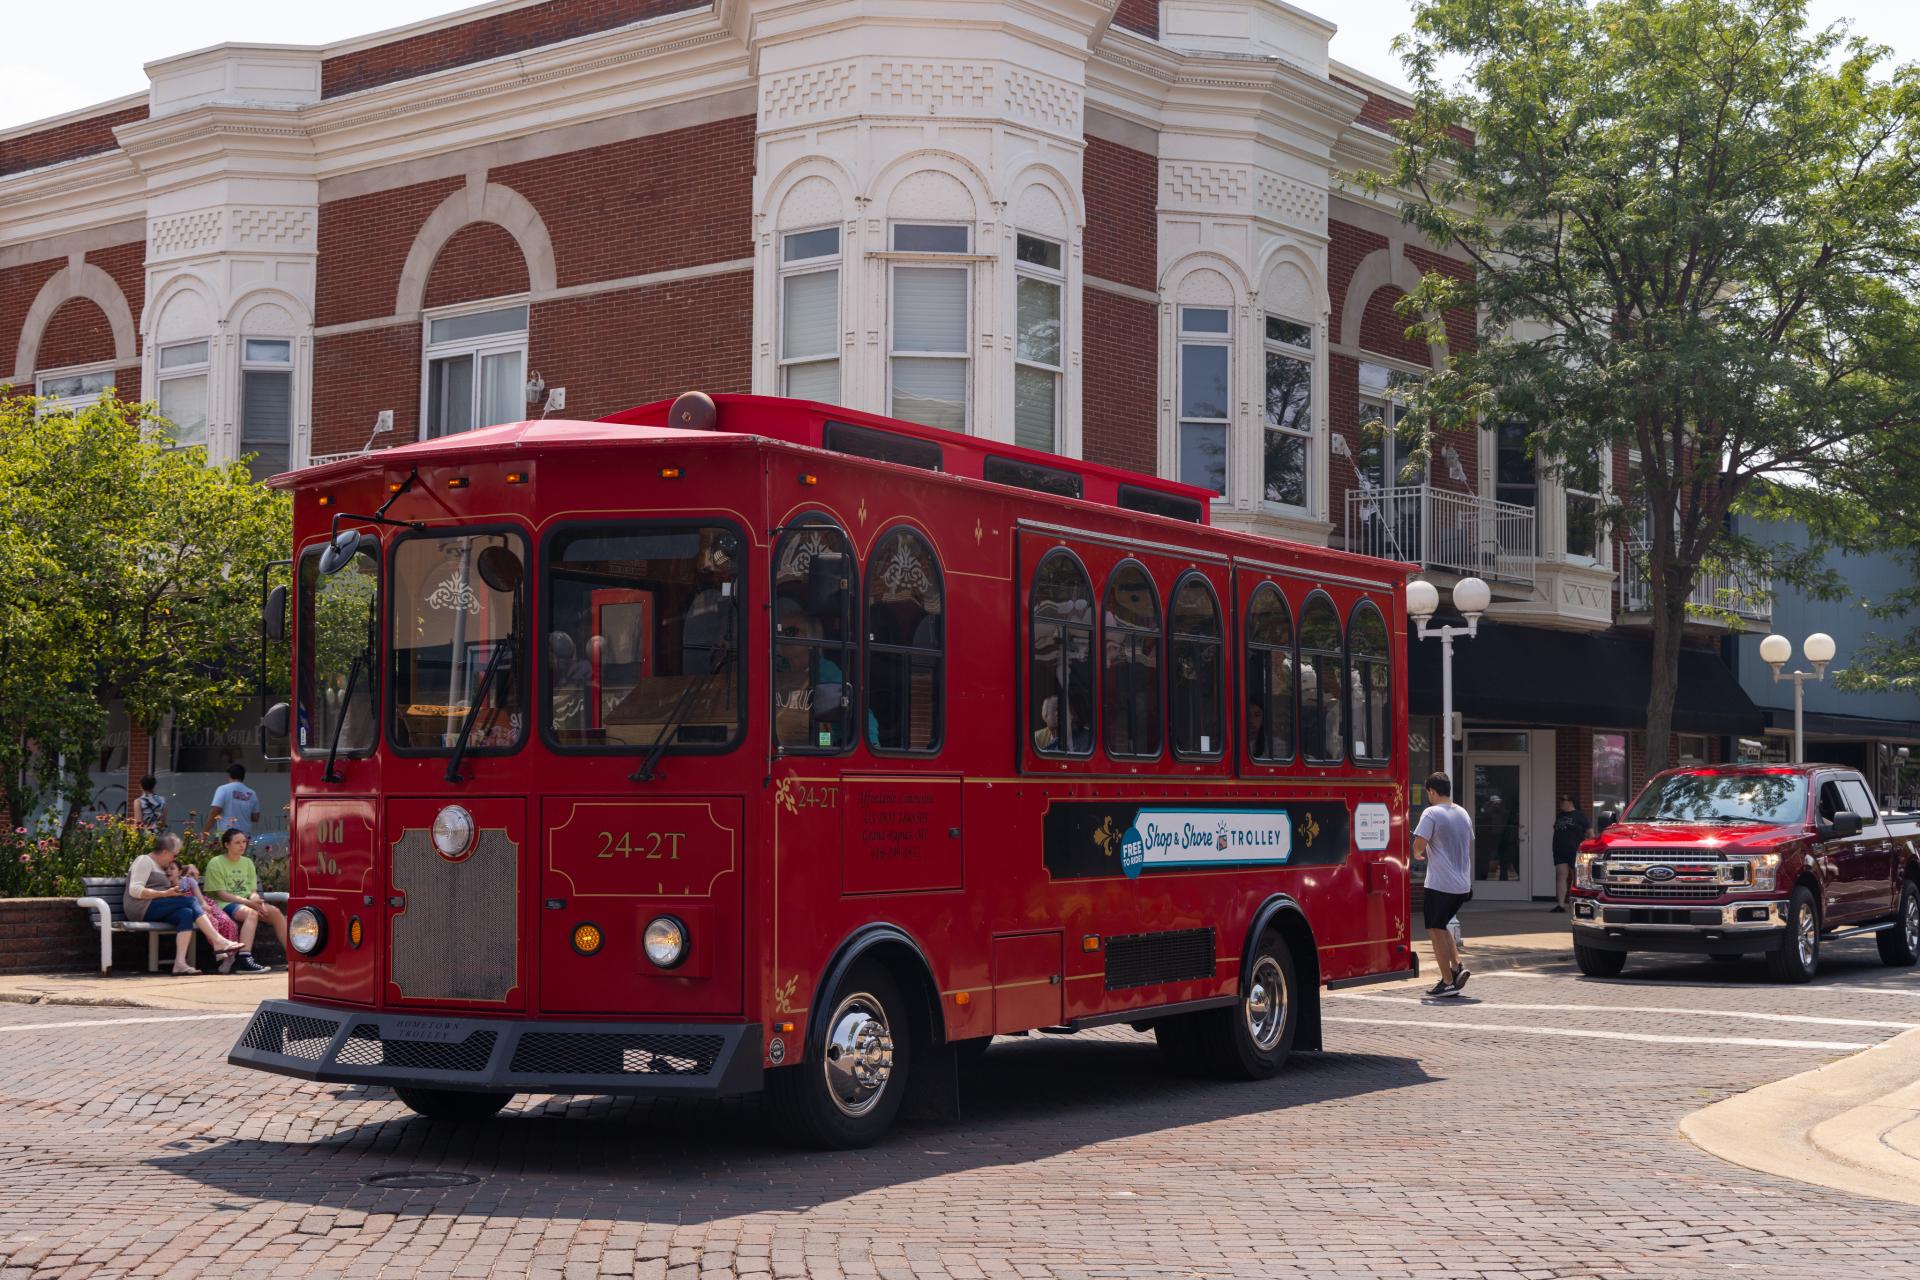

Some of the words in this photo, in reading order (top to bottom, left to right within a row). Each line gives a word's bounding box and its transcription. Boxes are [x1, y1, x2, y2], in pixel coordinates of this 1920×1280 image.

[799, 786, 838, 808] 24-2T
[318, 817, 344, 844] Old
[1145, 823, 1172, 855] Shop
[1174, 832, 1180, 845] &
[1181, 823, 1213, 849] Shore
[1231, 830, 1281, 847] TROLLEY
[596, 831, 686, 859] 24-2T
[1123, 841, 1142, 858] FREE
[317, 851, 342, 875] No.
[1123, 858, 1131, 867] TO
[396, 1020, 459, 1030] HOMETOWN
[399, 1030, 449, 1040] TROLLEY
